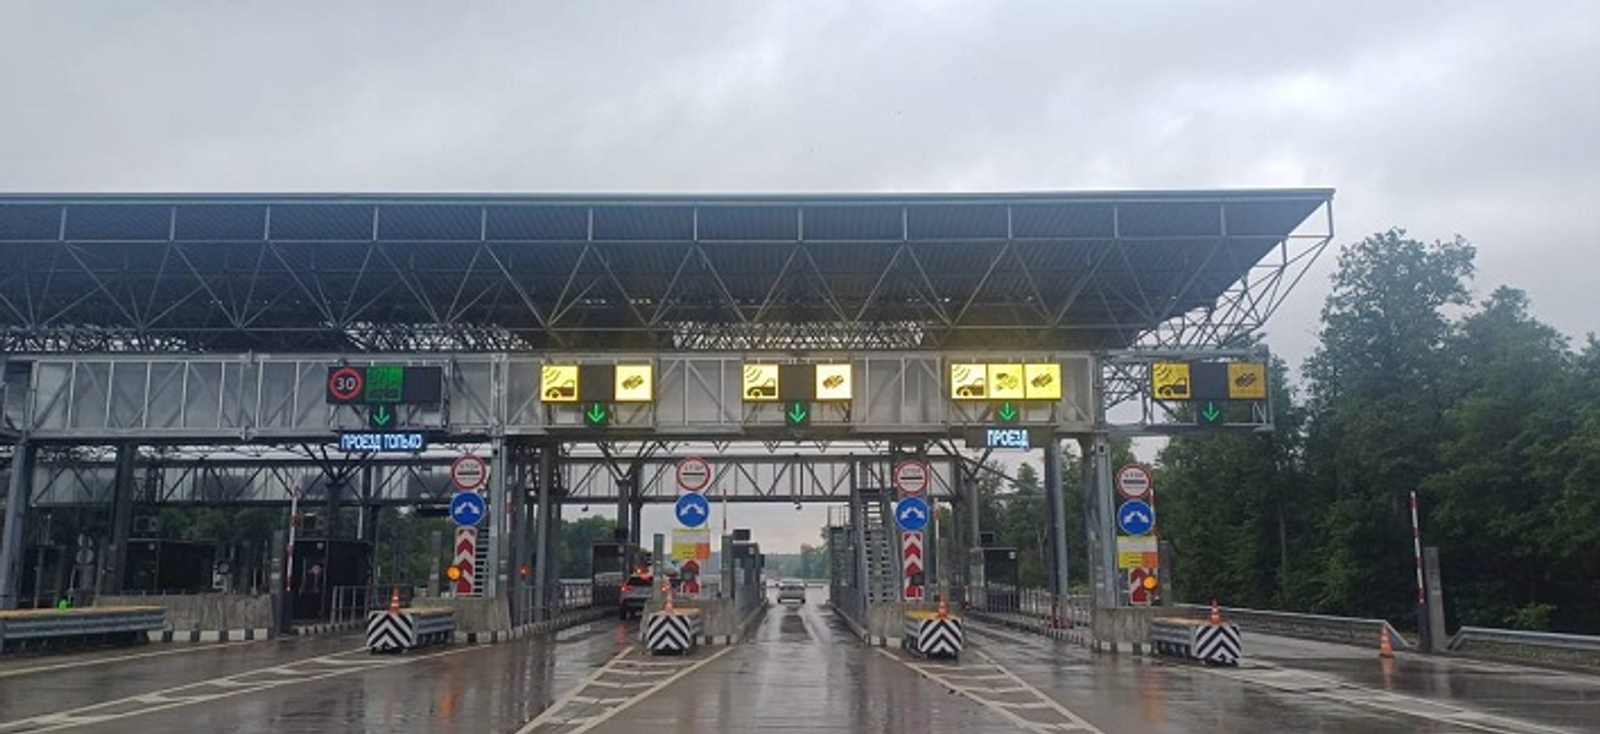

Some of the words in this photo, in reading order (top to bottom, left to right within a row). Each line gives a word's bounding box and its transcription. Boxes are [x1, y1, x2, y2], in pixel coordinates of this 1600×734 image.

[336, 377, 355, 390] 30
[341, 434, 382, 452] ПРОЕЗД
[987, 429, 1030, 449] ПРОЕЗД
